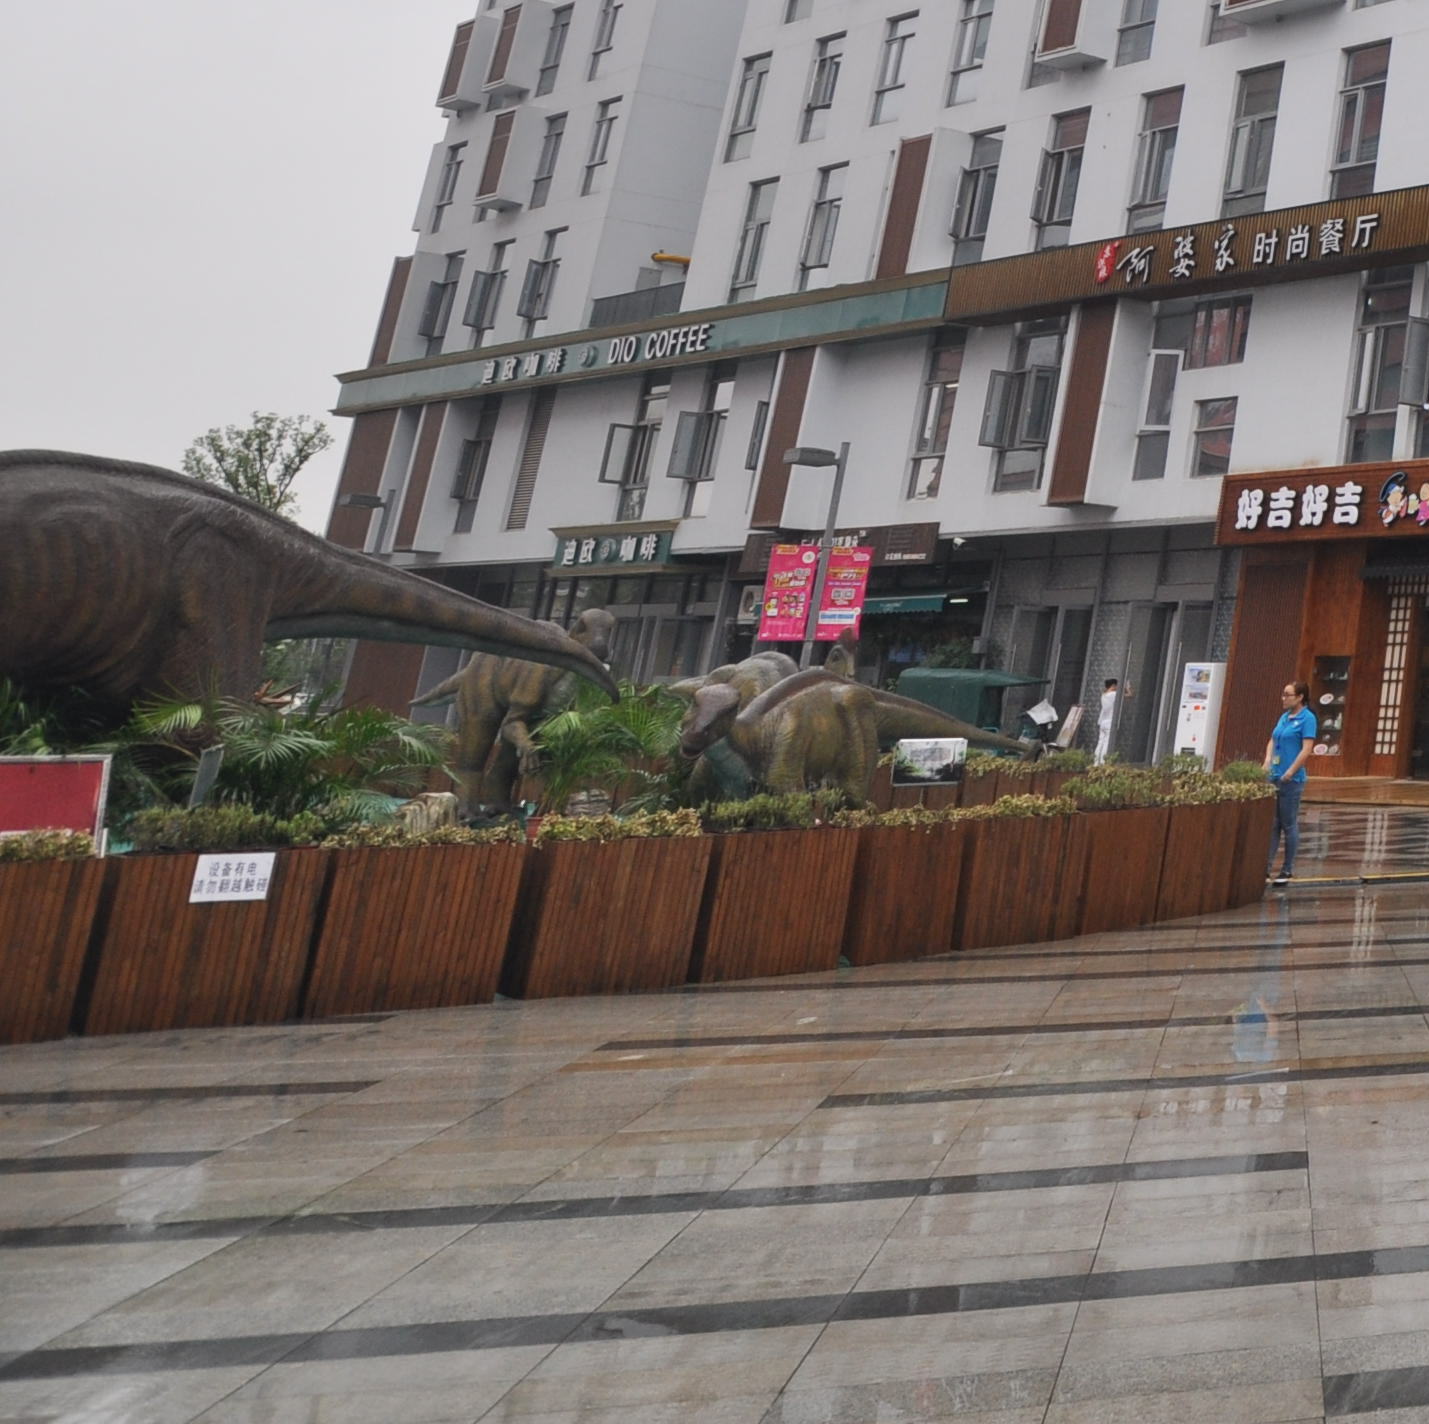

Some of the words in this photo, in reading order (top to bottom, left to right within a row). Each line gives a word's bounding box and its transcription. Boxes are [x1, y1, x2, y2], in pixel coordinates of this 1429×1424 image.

[608, 336, 638, 365] DIO
[644, 324, 711, 359] COFFEE
[1234, 480, 1363, 531] 好吉好吉
